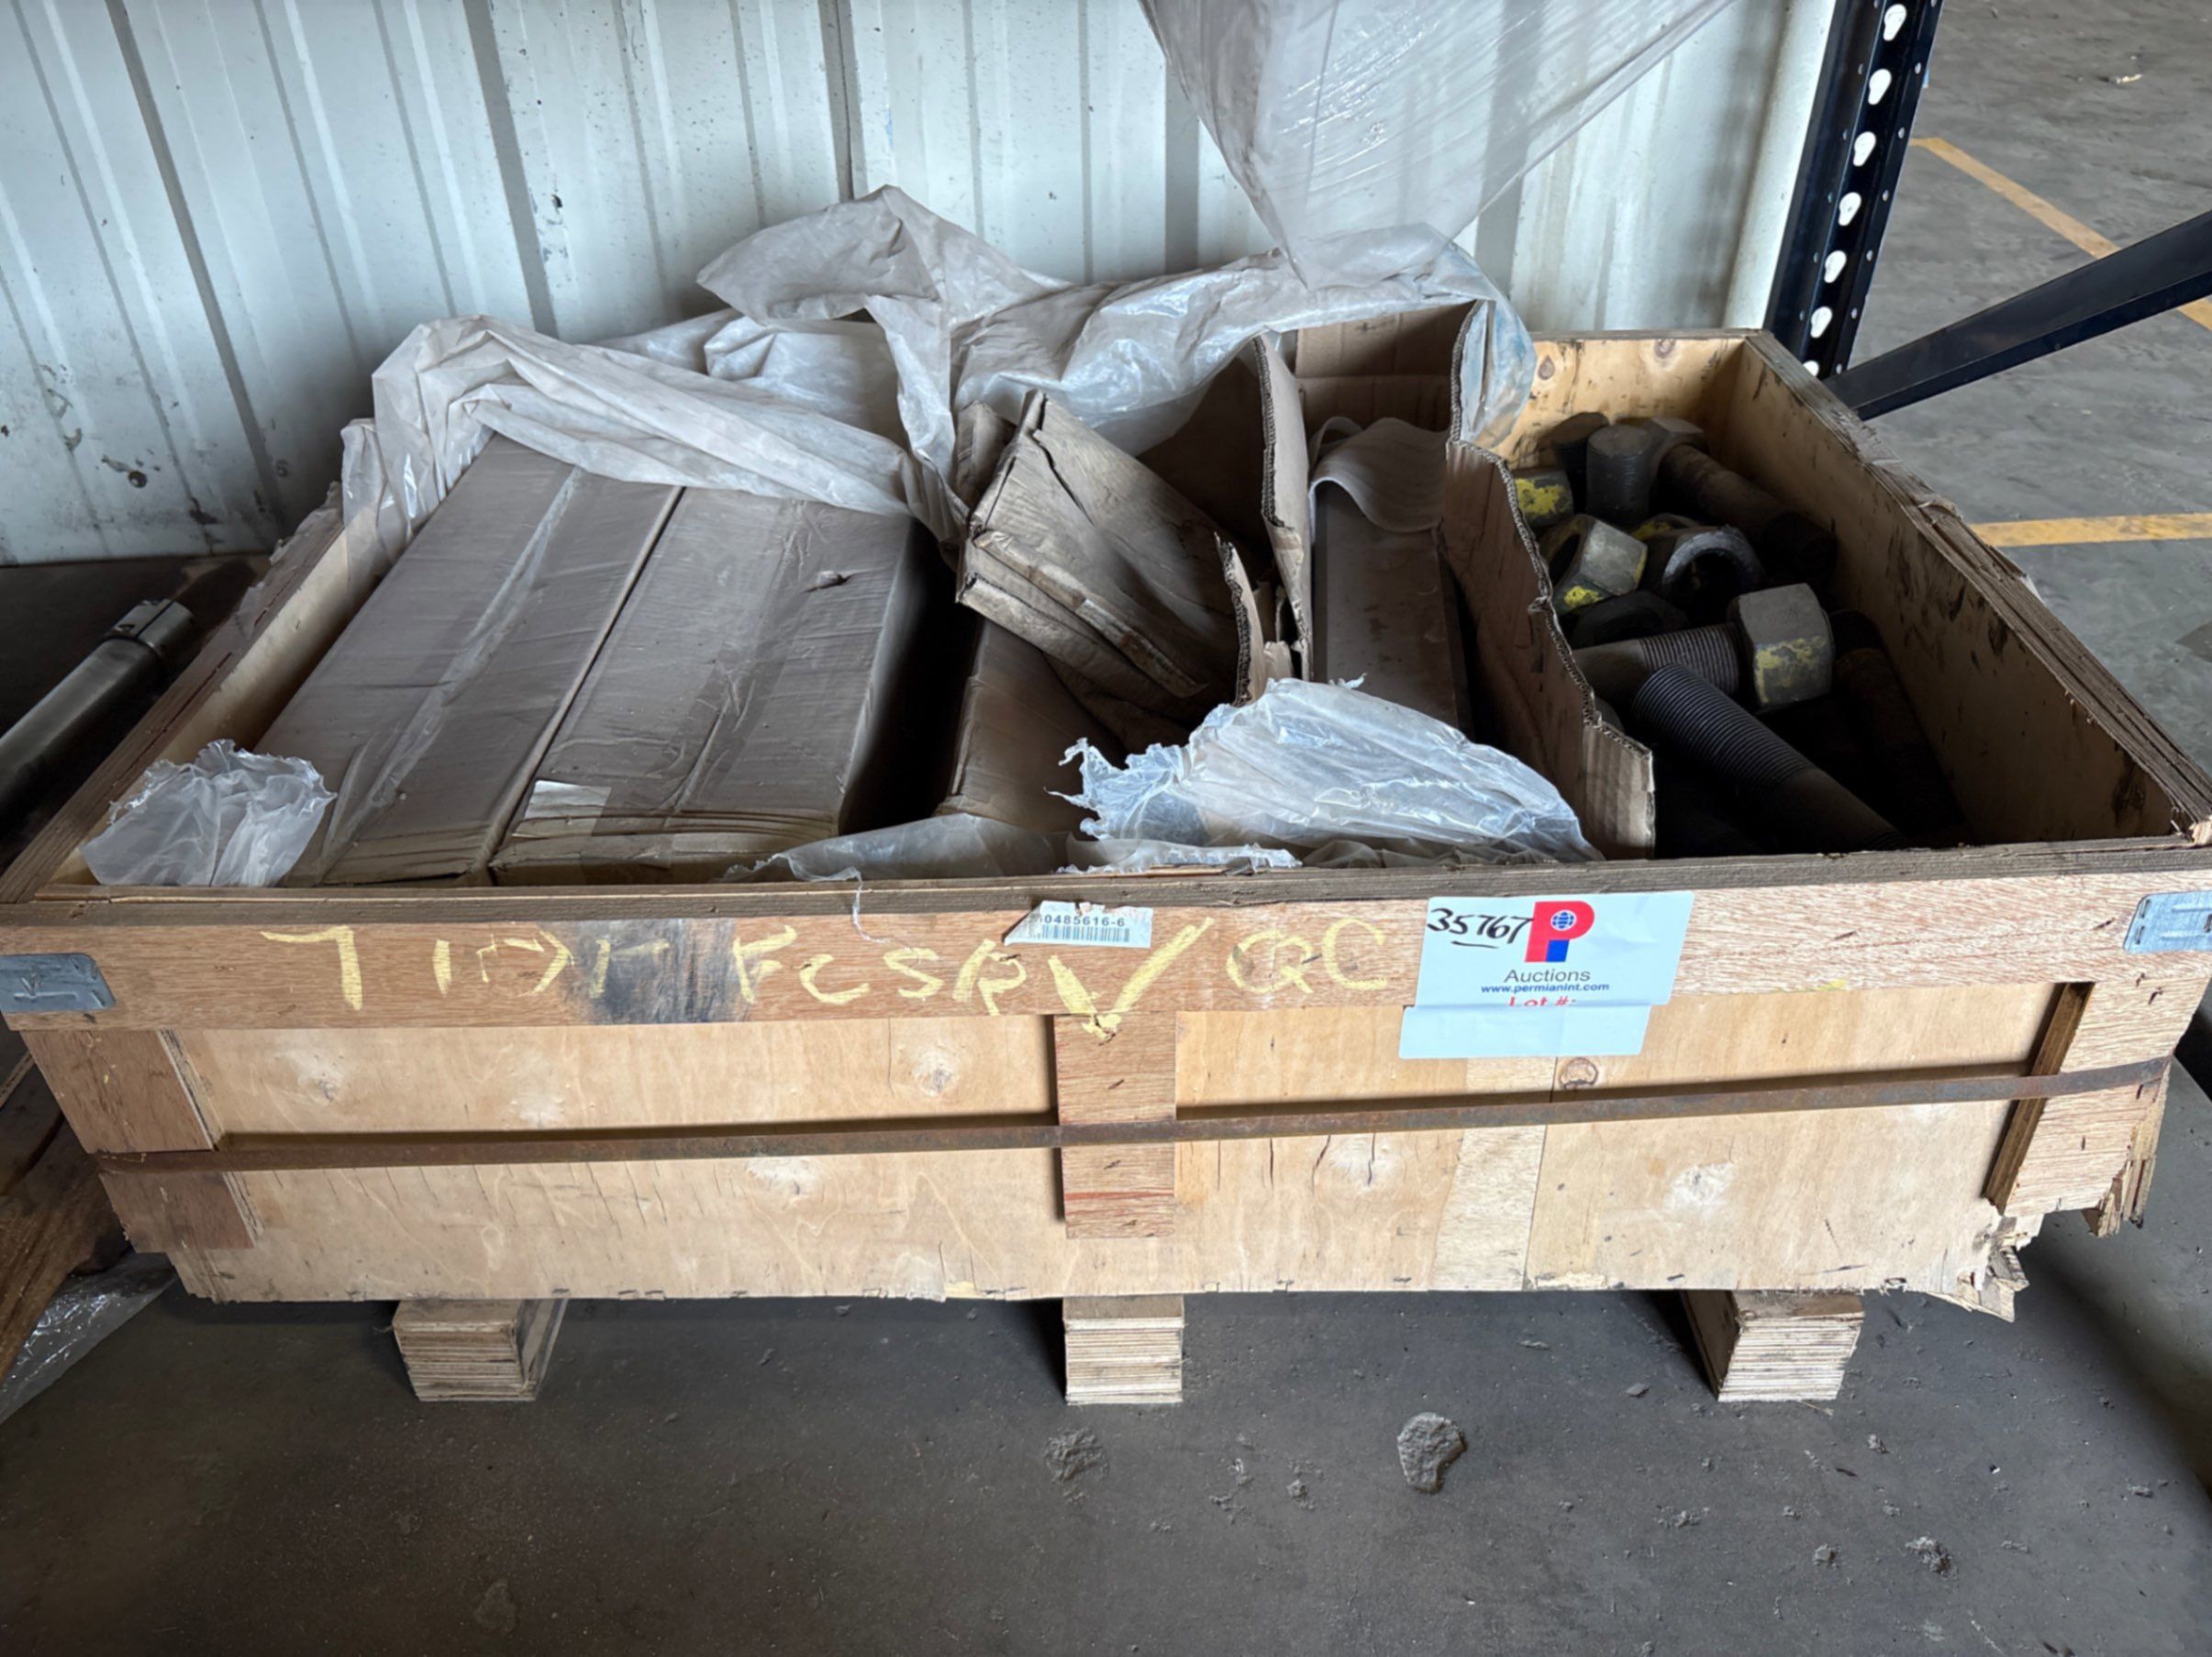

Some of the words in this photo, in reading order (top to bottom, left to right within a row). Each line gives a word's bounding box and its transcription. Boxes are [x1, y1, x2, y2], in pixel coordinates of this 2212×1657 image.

[1427, 907, 1534, 944] 35767
[1503, 968, 1592, 984] Auctions
[1480, 982, 1610, 995] www.permianint.com
